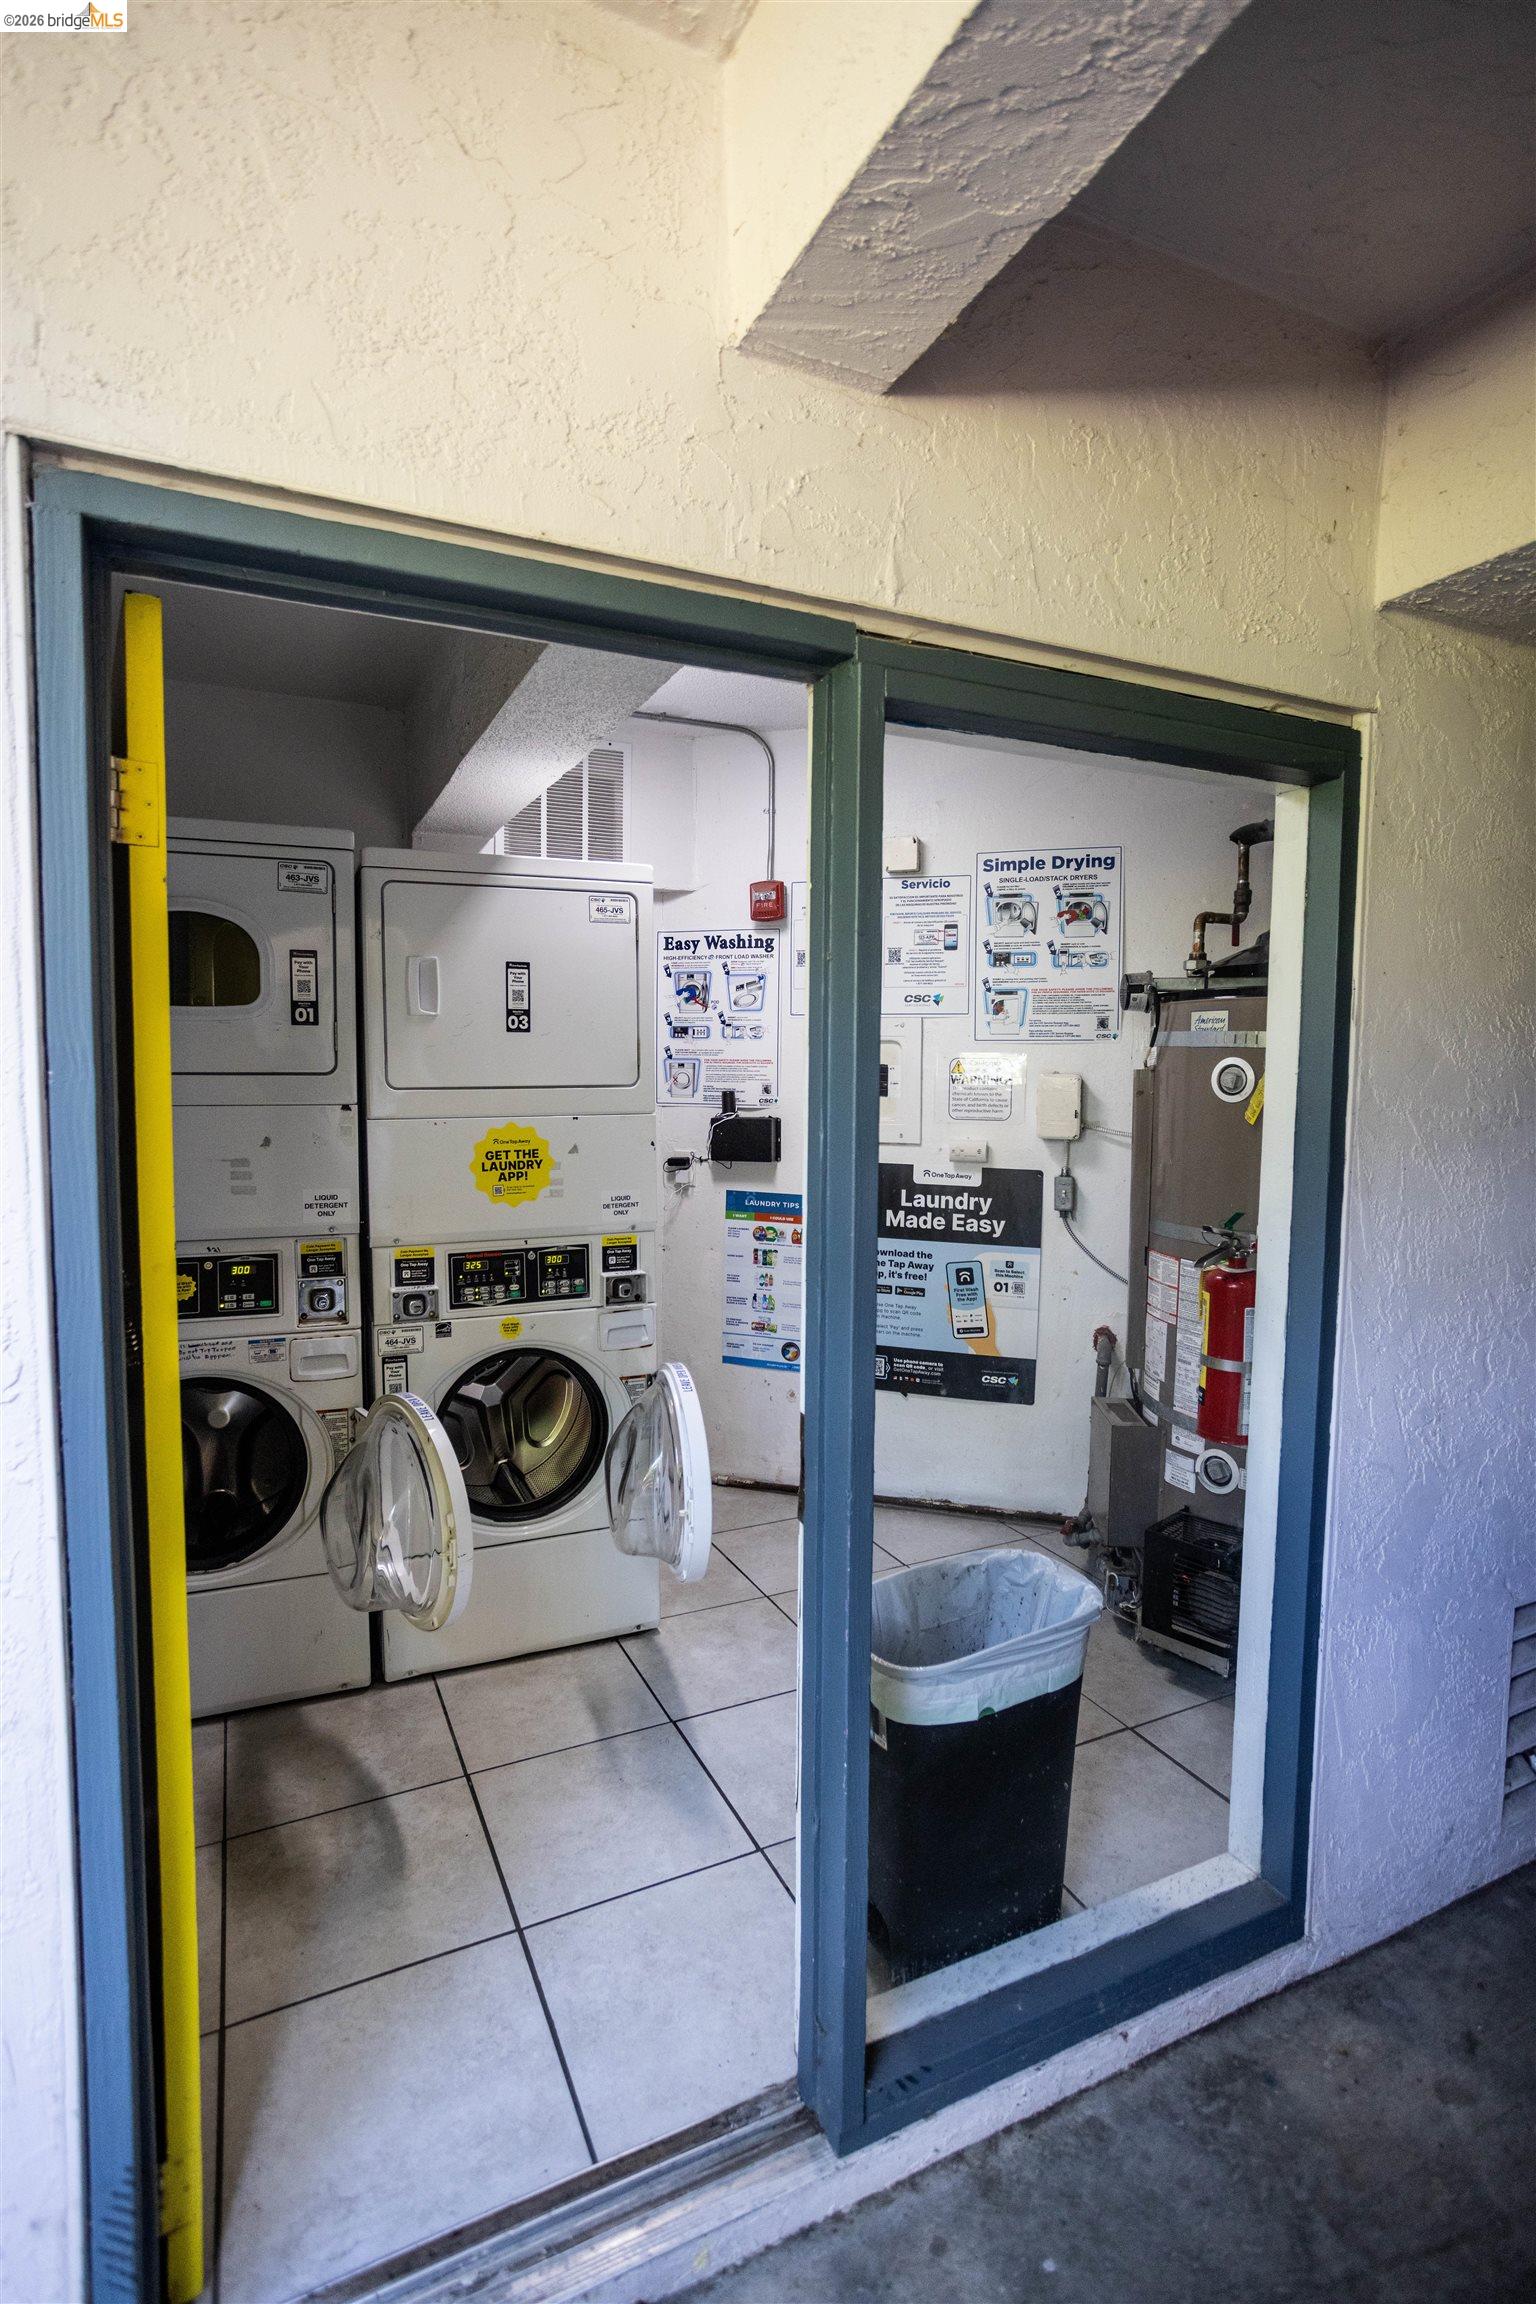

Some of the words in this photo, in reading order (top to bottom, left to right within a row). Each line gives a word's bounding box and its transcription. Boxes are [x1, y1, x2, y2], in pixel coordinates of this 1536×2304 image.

[983, 856, 1046, 873] Simple
[1052, 854, 1115, 871] Drying
[286, 874, 320, 882] 463-JVS
[902, 879, 950, 889] Servicio
[663, 936, 700, 954] Easy
[704, 934, 775, 952] Washing
[295, 1008, 314, 1022] 01
[508, 1016, 528, 1029] 03
[485, 1150, 511, 1160] GET
[514, 1149, 539, 1159] THE
[482, 1159, 543, 1172] LAUNDRY
[498, 1171, 528, 1182] APP!
[901, 1189, 992, 1215] Laundry
[886, 1210, 946, 1230] Made
[952, 1214, 1006, 1238] Easy
[876, 1250, 914, 1258] ownload
[917, 1251, 933, 1259] the
[232, 1266, 250, 1274] 300
[888, 1260, 905, 1270] Tap
[908, 1262, 934, 1272] Away
[889, 1270, 902, 1278] it's
[905, 1272, 927, 1281] free!
[994, 1282, 1008, 1292] 01
[893, 1367, 941, 1376] GetOneTapAway.com
[982, 1376, 1006, 1384] CSC
